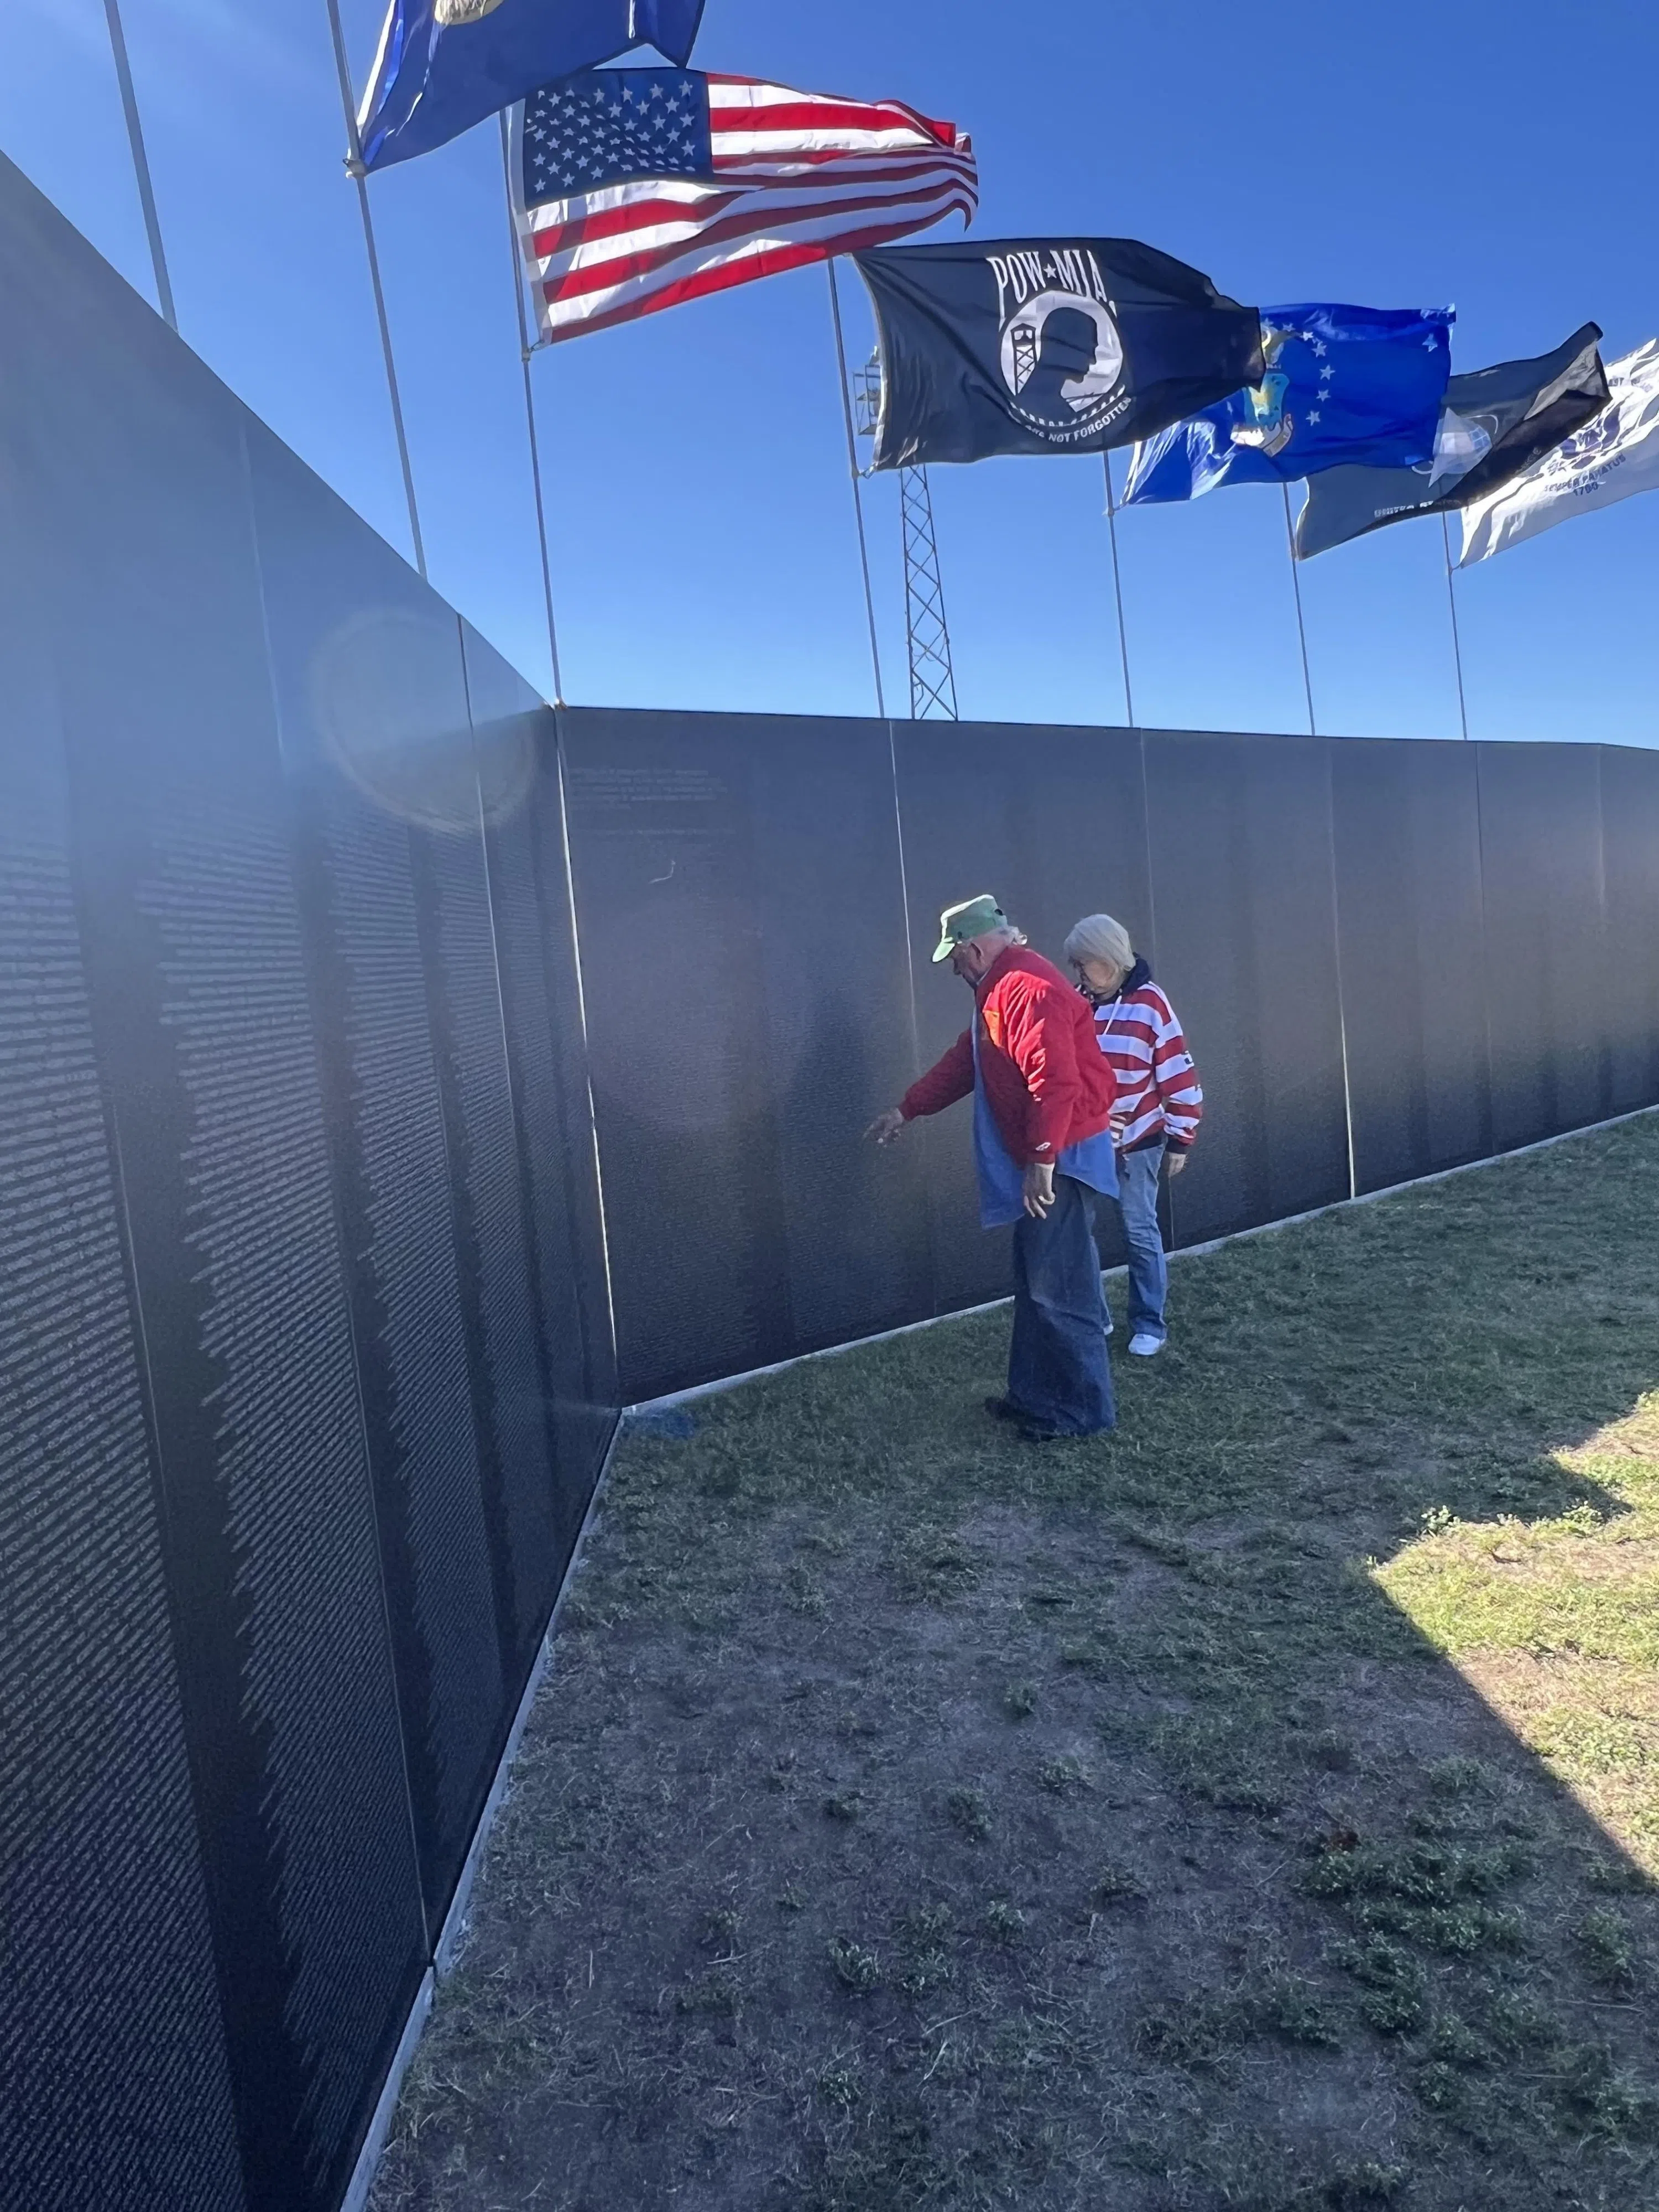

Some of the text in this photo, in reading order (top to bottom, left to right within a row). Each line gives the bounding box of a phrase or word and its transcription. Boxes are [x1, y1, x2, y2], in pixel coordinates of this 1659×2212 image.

[986, 249, 1108, 326] POW MIA
[1048, 432, 1073, 442] NOT
[1074, 396, 1132, 441] FORGOTTEN
